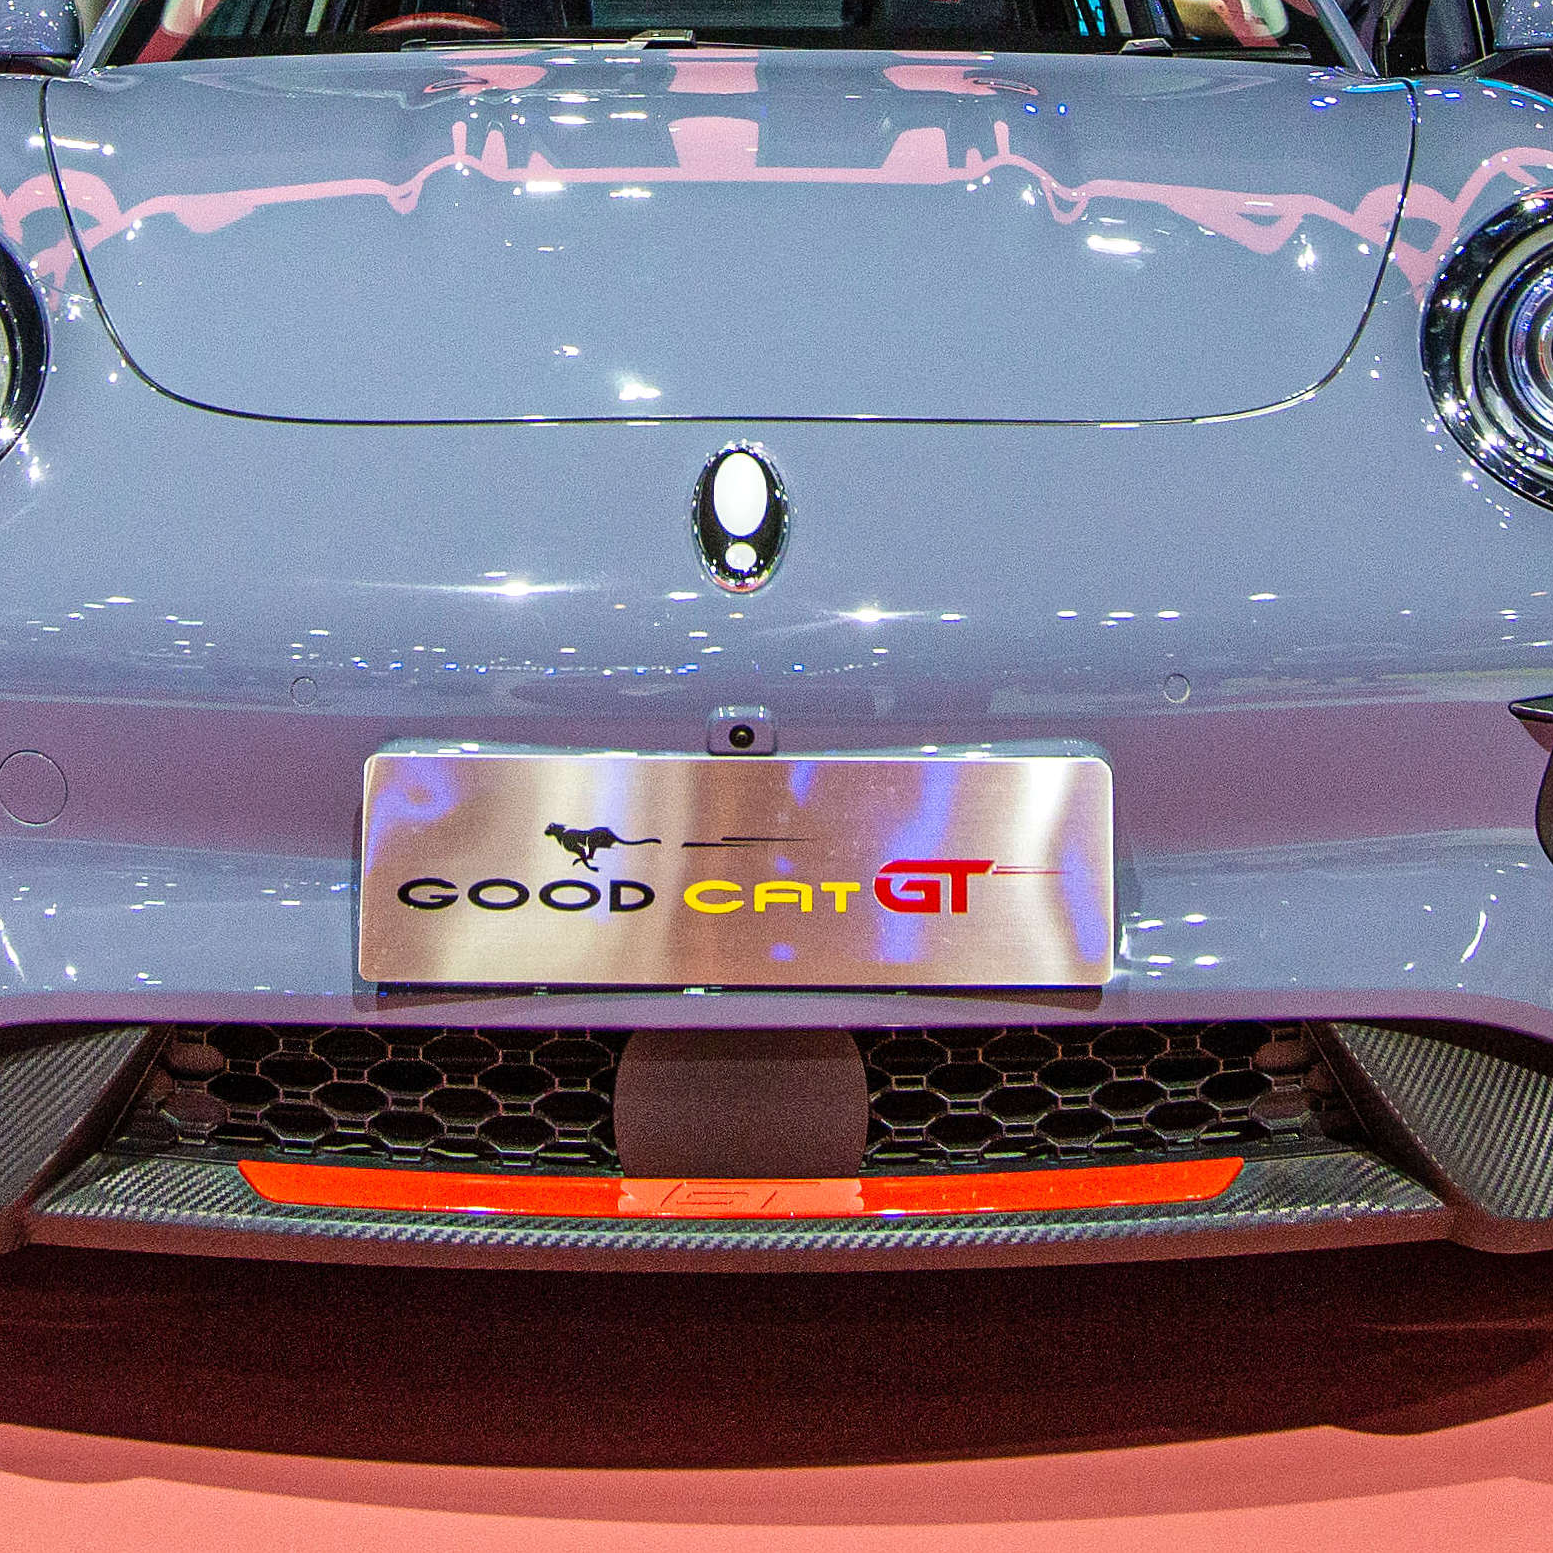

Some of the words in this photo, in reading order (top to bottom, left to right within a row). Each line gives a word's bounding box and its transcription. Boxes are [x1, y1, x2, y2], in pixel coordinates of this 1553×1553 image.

[396, 876, 656, 913] GOOD
[683, 880, 862, 915] CAT
[872, 858, 996, 916] GT
